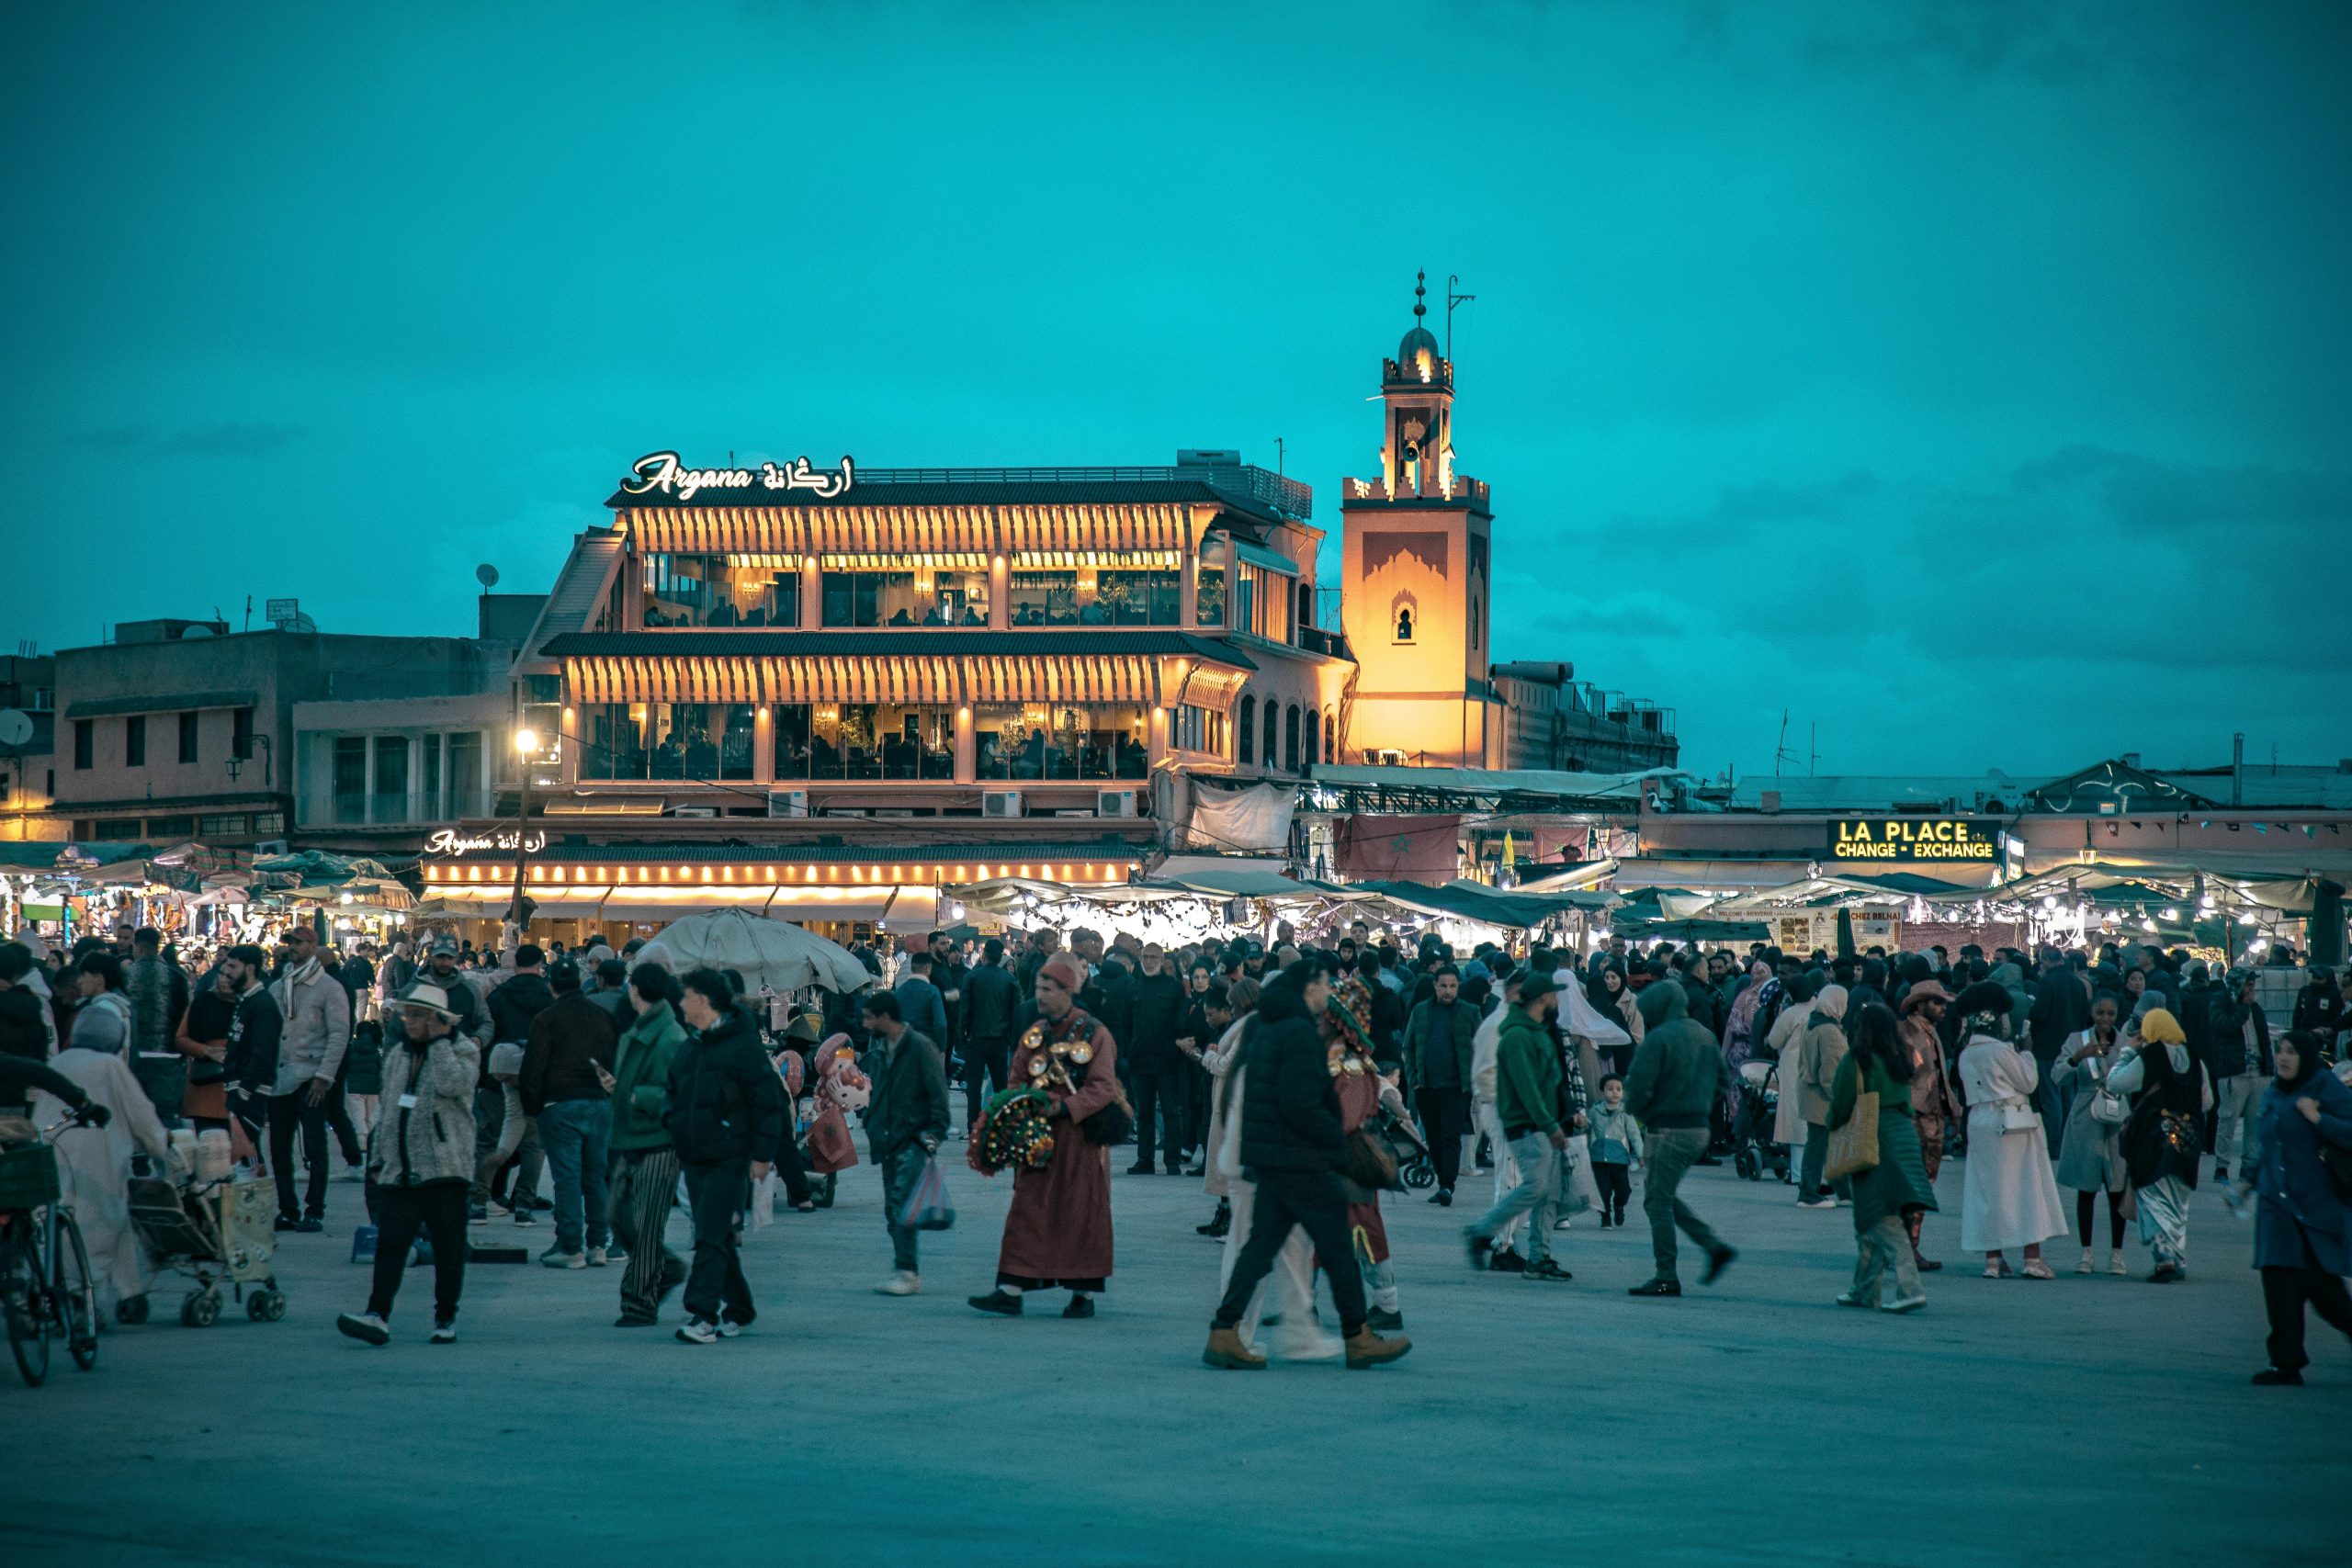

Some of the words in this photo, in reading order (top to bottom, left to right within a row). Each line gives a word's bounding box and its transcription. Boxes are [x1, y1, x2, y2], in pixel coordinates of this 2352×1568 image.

[622, 454, 754, 501] Argana
[1840, 821, 1871, 841] LA
[1886, 821, 1968, 841] PLACE
[424, 829, 494, 856] Argana
[1835, 842, 1896, 857] CHANGE
[1914, 842, 1993, 858] EXCHANGE
[1850, 912, 1871, 920] CHEZ
